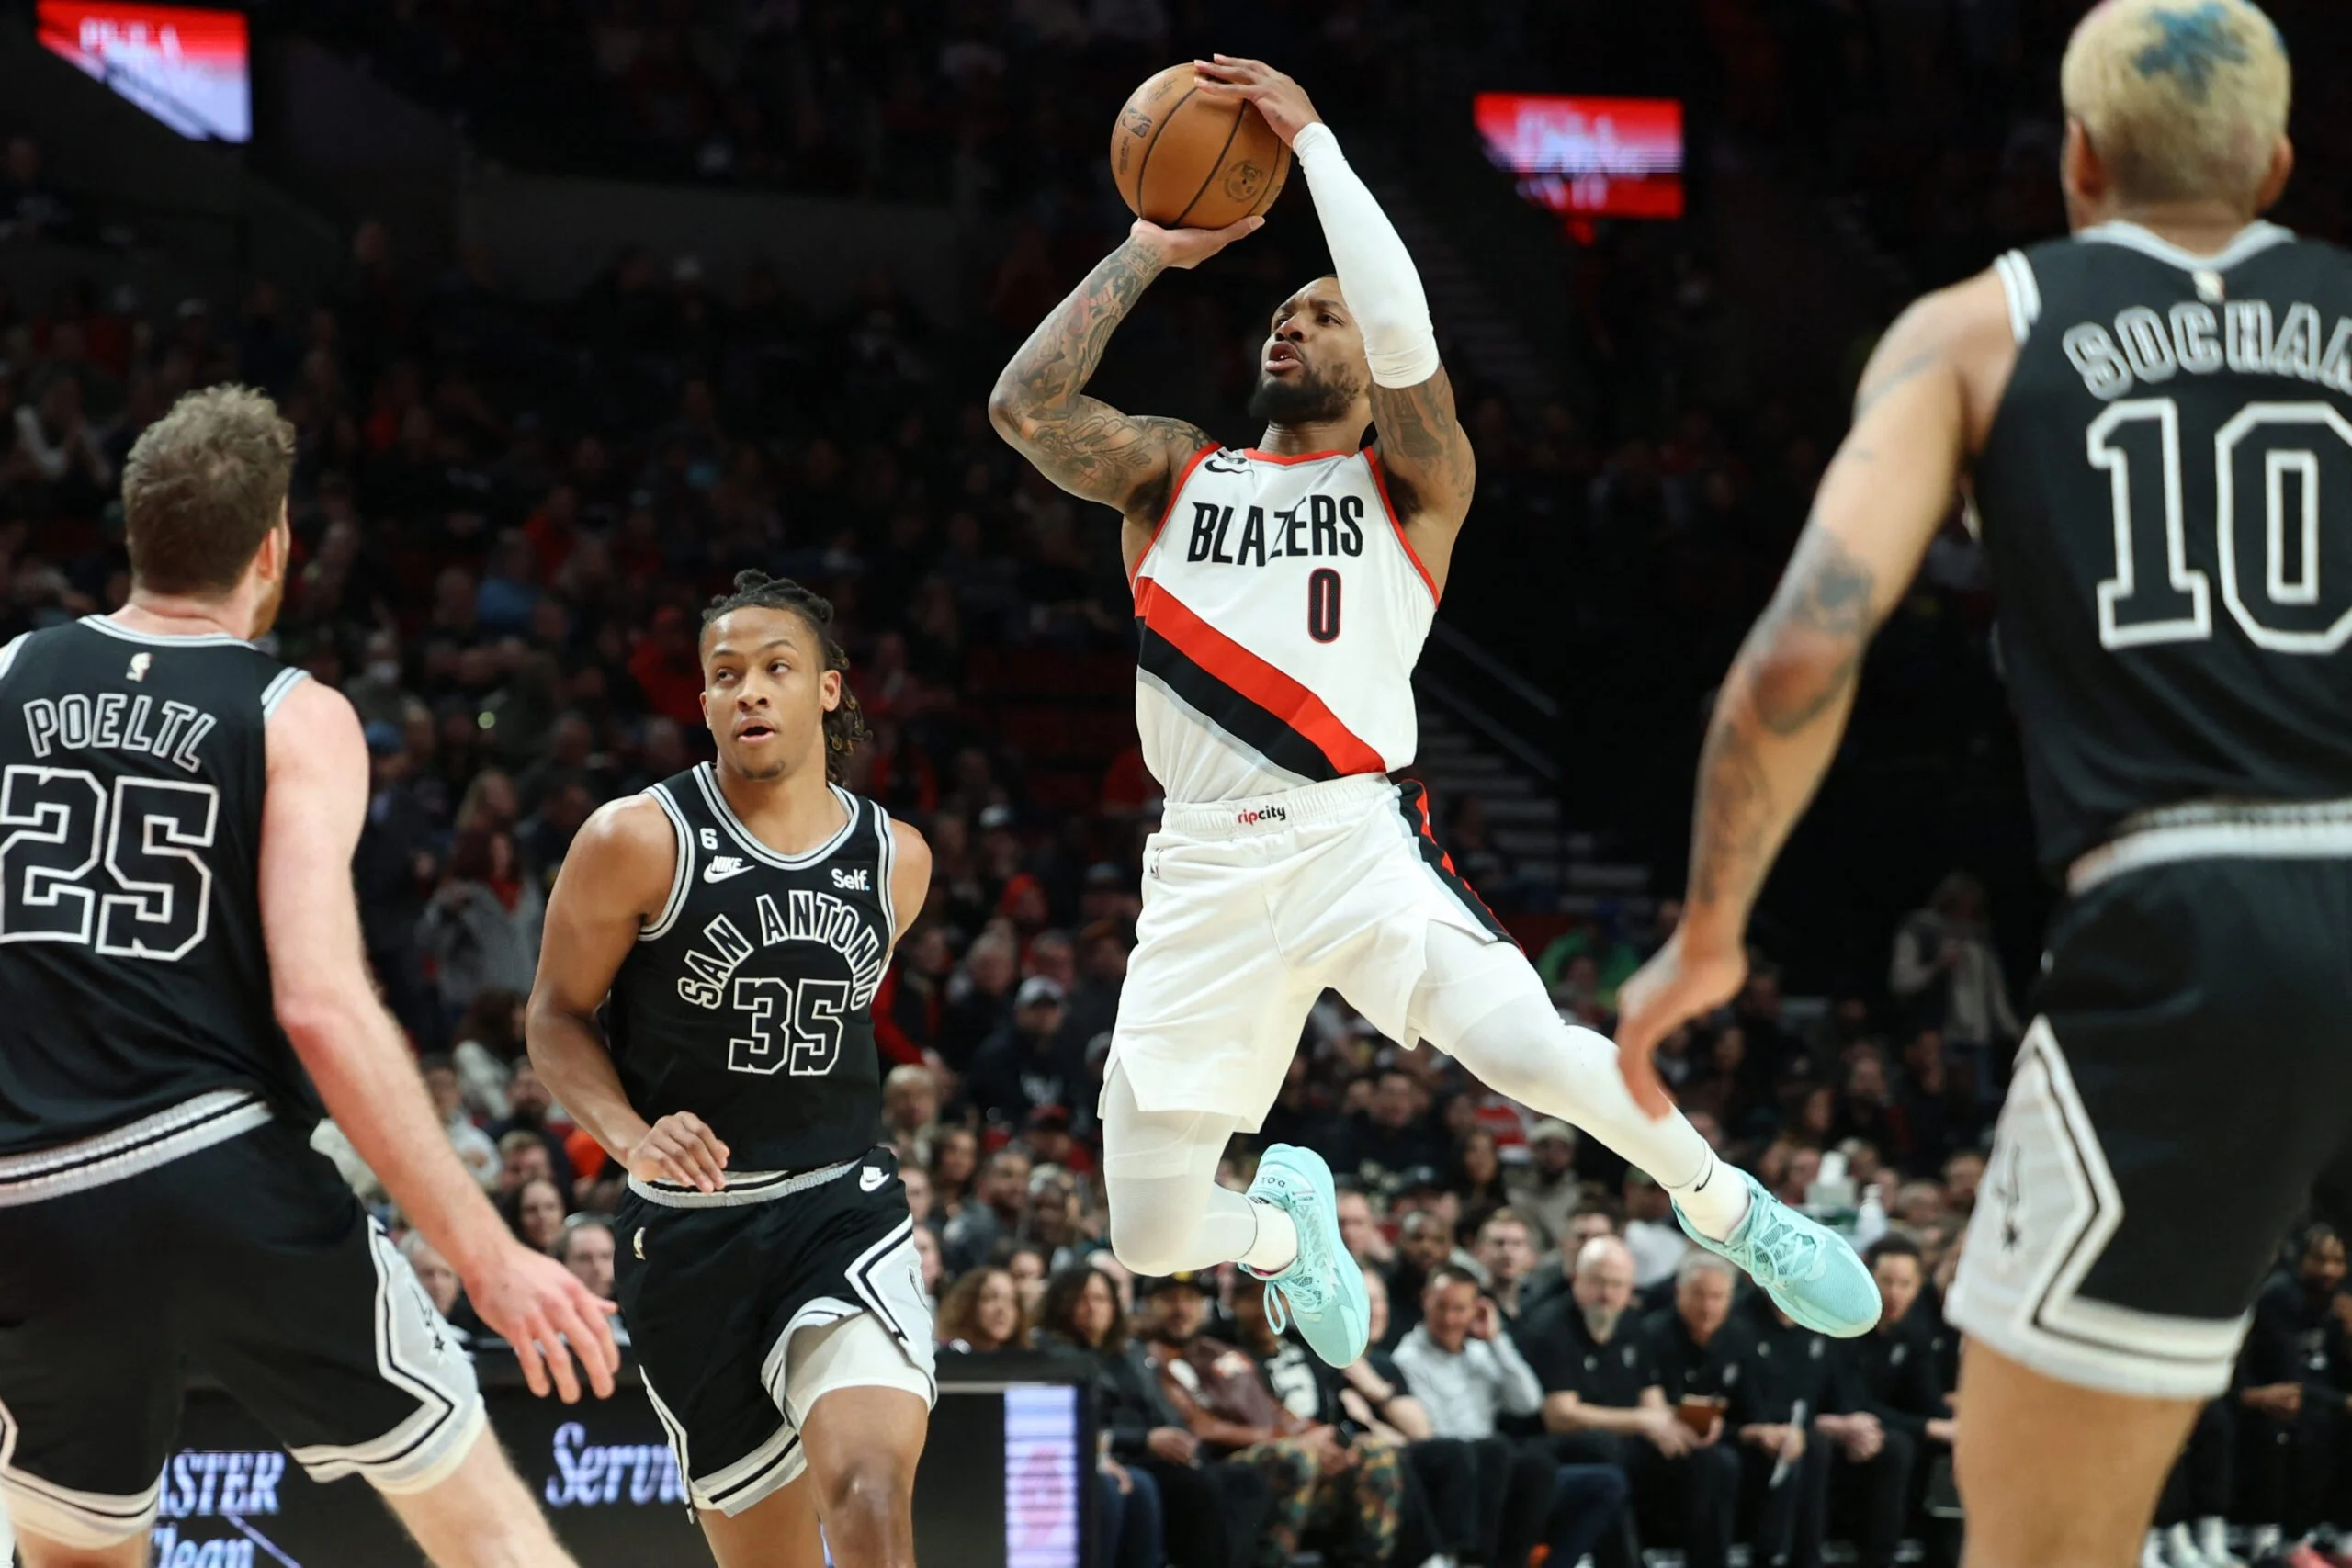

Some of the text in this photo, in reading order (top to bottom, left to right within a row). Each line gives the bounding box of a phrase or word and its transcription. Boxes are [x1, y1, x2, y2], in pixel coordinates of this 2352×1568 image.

[1186, 494, 1364, 567] BLAZERS
[2086, 397, 2352, 653] 10
[1307, 567, 1342, 644] 0
[23, 693, 218, 773] POELTL
[699, 827, 718, 851] 6
[1238, 805, 1287, 826] ripcity
[0, 764, 220, 962] 25
[711, 855, 743, 873] NIKE
[677, 913, 754, 1010] SAN
[728, 977, 851, 1076] 35
[545, 1420, 686, 1509] Servi
